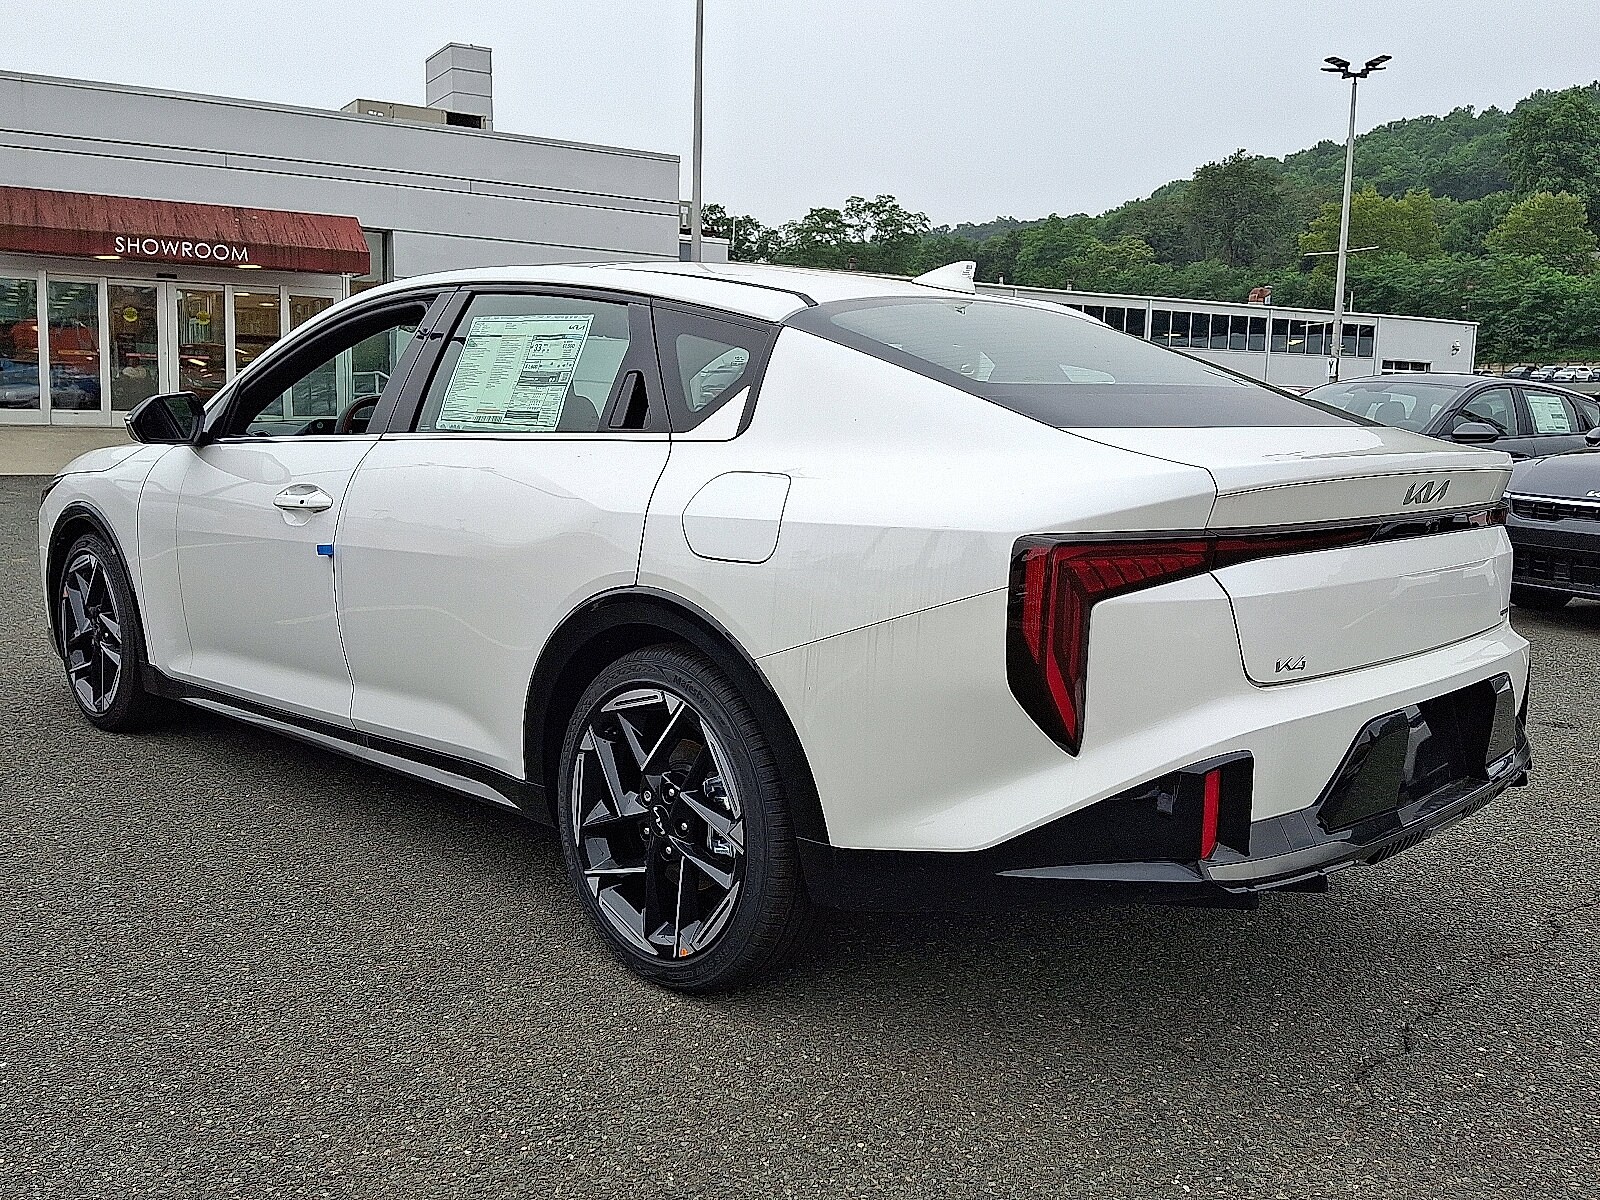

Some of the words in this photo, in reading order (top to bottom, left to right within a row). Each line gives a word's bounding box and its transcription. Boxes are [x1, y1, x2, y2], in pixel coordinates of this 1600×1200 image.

[114, 236, 249, 262] SHOWROOM
[1402, 479, 1450, 506] KIA
[1274, 655, 1306, 673] K4
